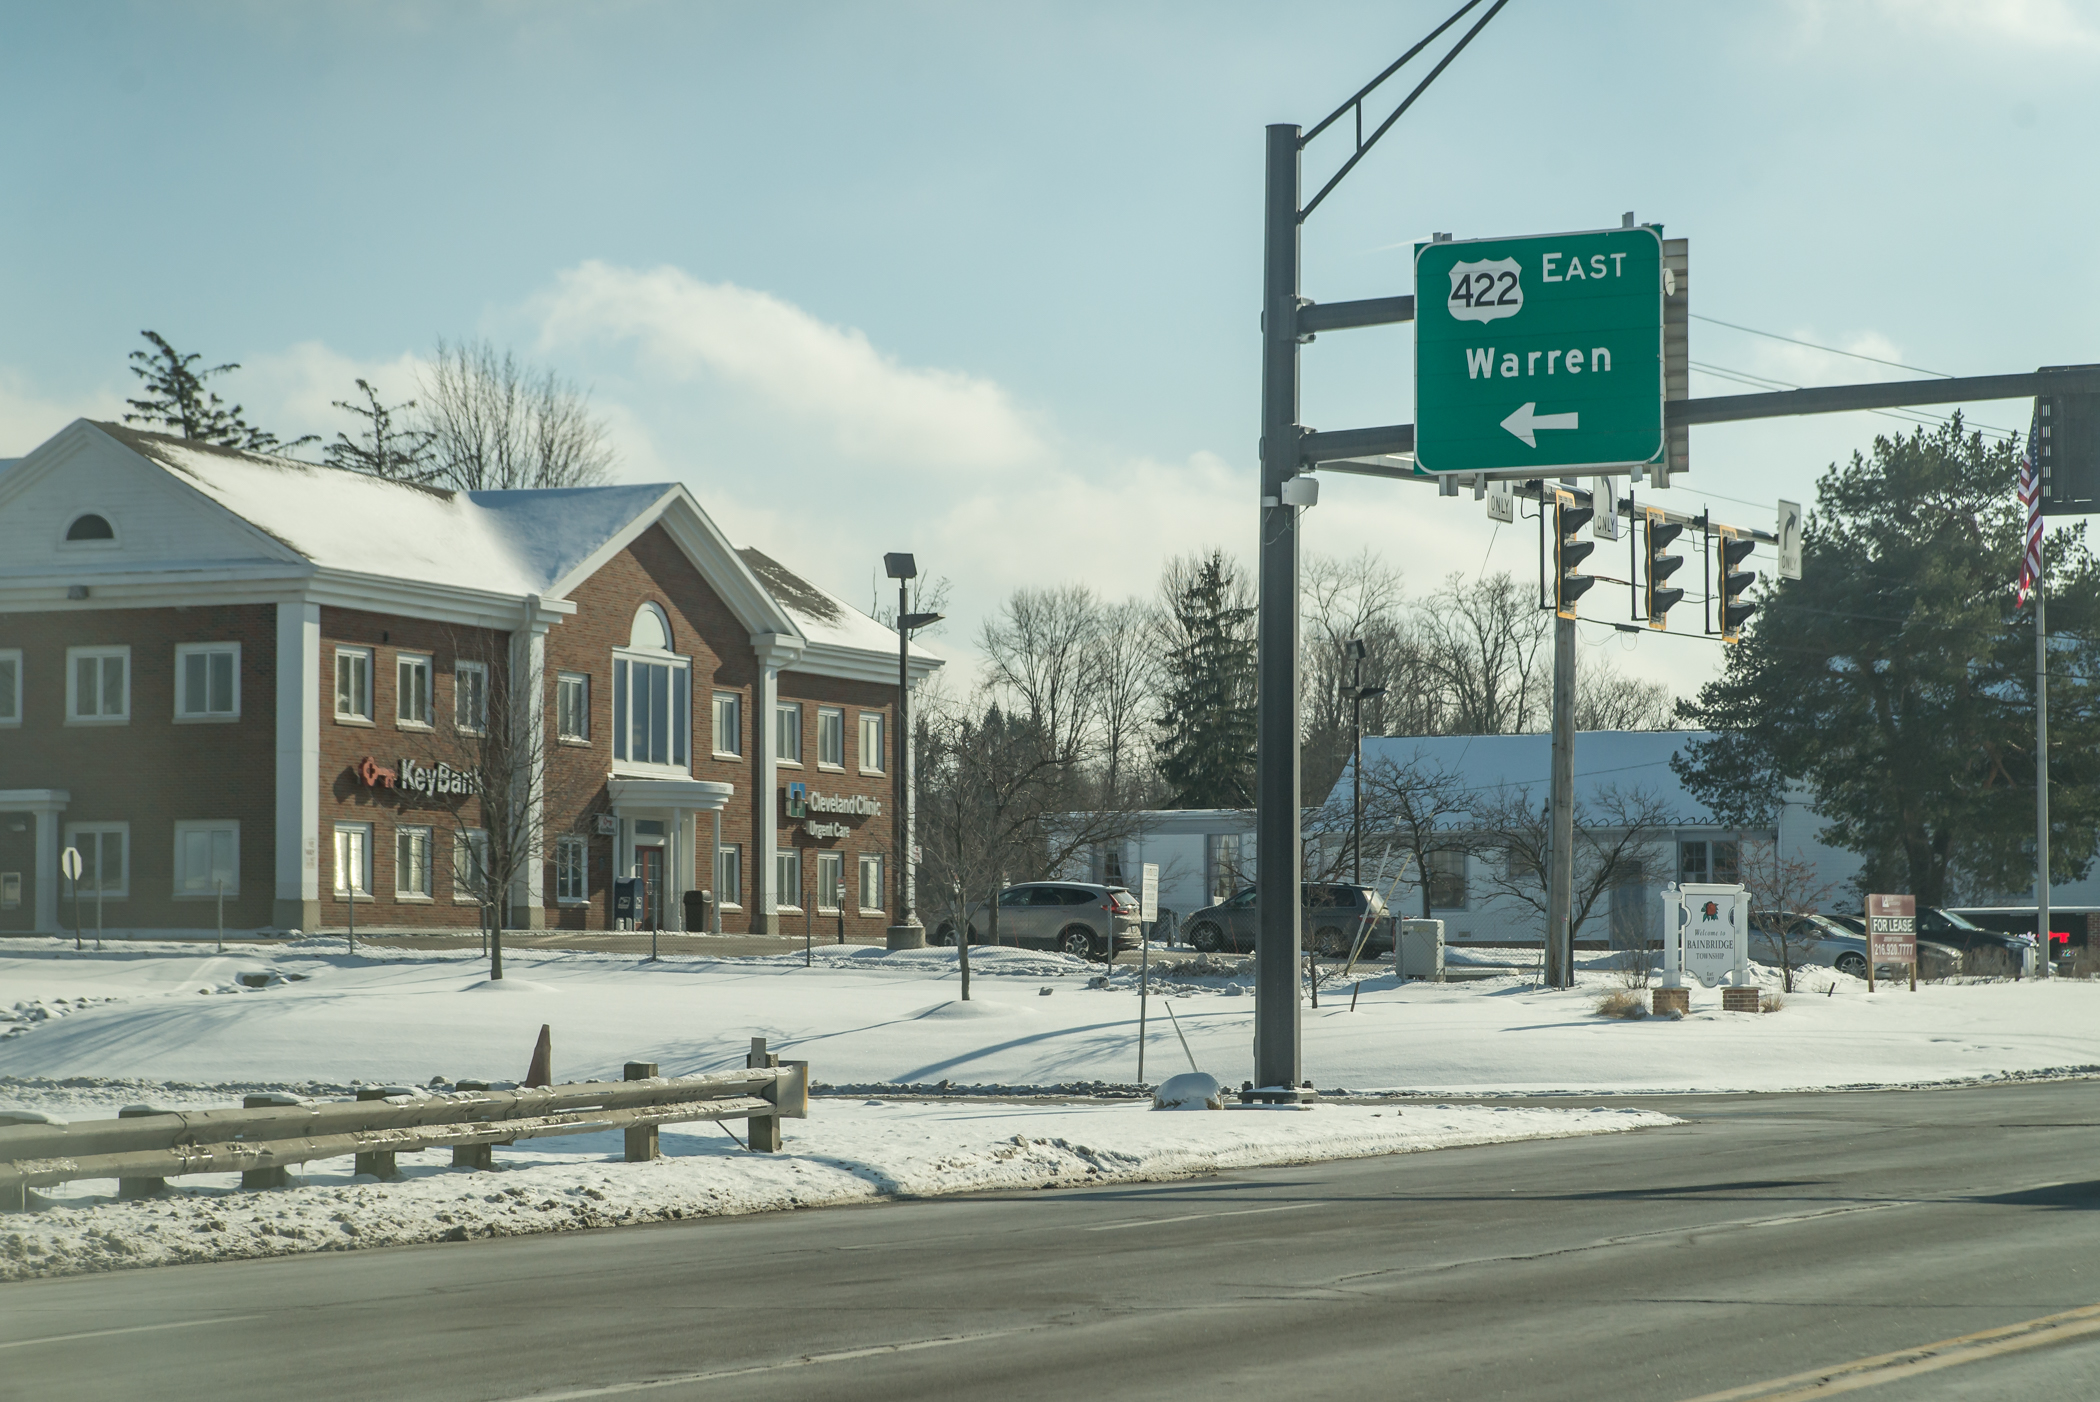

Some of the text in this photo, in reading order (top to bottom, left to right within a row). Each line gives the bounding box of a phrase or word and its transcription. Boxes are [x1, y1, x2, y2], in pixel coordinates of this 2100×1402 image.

[1450, 252, 1627, 308] 422 EAST
[1466, 347, 1611, 380] Warren
[1490, 493, 1510, 515] ONLY
[1597, 514, 1615, 534] ONLY
[1781, 553, 1799, 571] ONLY
[810, 791, 882, 817] Cleveland Clinic
[809, 820, 851, 840] Urgent Care
[1873, 919, 1913, 932] FOR LEASE
[1687, 940, 1733, 949] BAINBRIDGE
[1875, 944, 1913, 955] 216.920.7777
